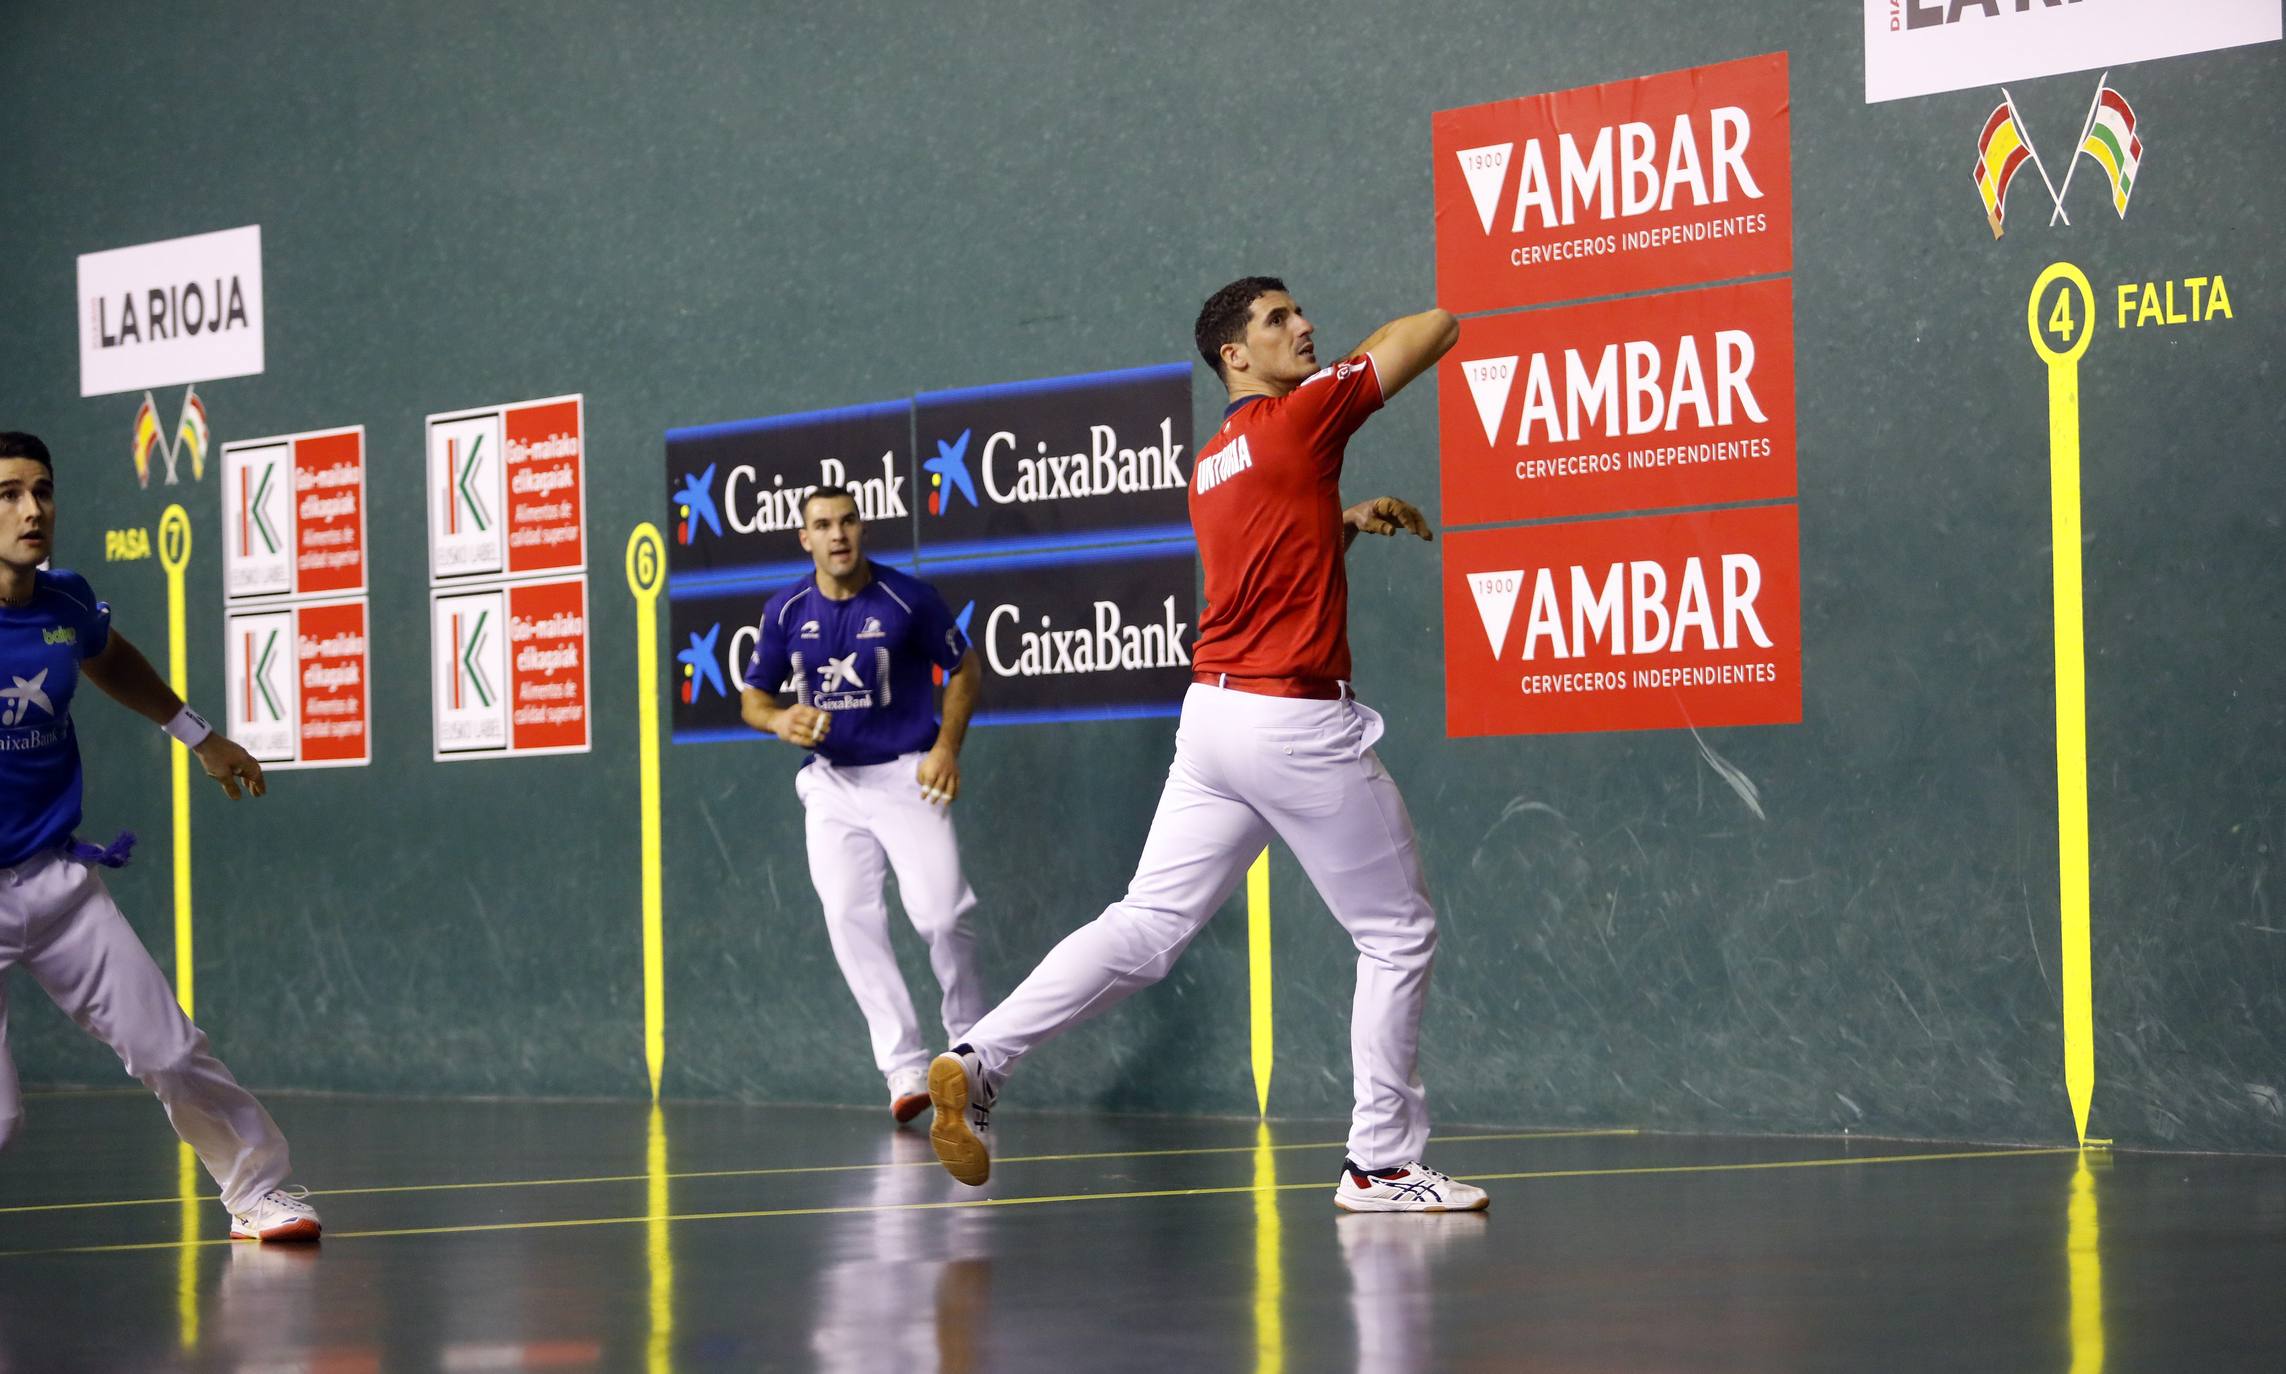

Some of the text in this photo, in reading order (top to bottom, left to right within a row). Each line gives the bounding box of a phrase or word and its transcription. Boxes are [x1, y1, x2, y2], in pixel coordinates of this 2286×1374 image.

[1467, 152, 1503, 171] 1900
[1511, 105, 1765, 233] AMBAR
[1511, 213, 1767, 266] CERVECEROS INDEPENDIENTES
[99, 292, 141, 348] LA
[148, 275, 248, 341] RIOJA
[2048, 275, 2233, 342] 4 FALTA
[1472, 364, 1508, 382] 1900
[1516, 329, 1769, 446] AMBAR
[981, 416, 1188, 504] CaixaBank
[1515, 437, 1771, 480] CERVECEROS INDEPENDIENTES
[724, 450, 909, 535] Caixank
[637, 541, 654, 585] 6
[1478, 579, 1514, 595] 1900
[985, 594, 1190, 677] CaixaBank
[1522, 553, 1774, 661] AMBAR
[1521, 662, 1776, 695] CERVECEROS INDEPENDIENTES
